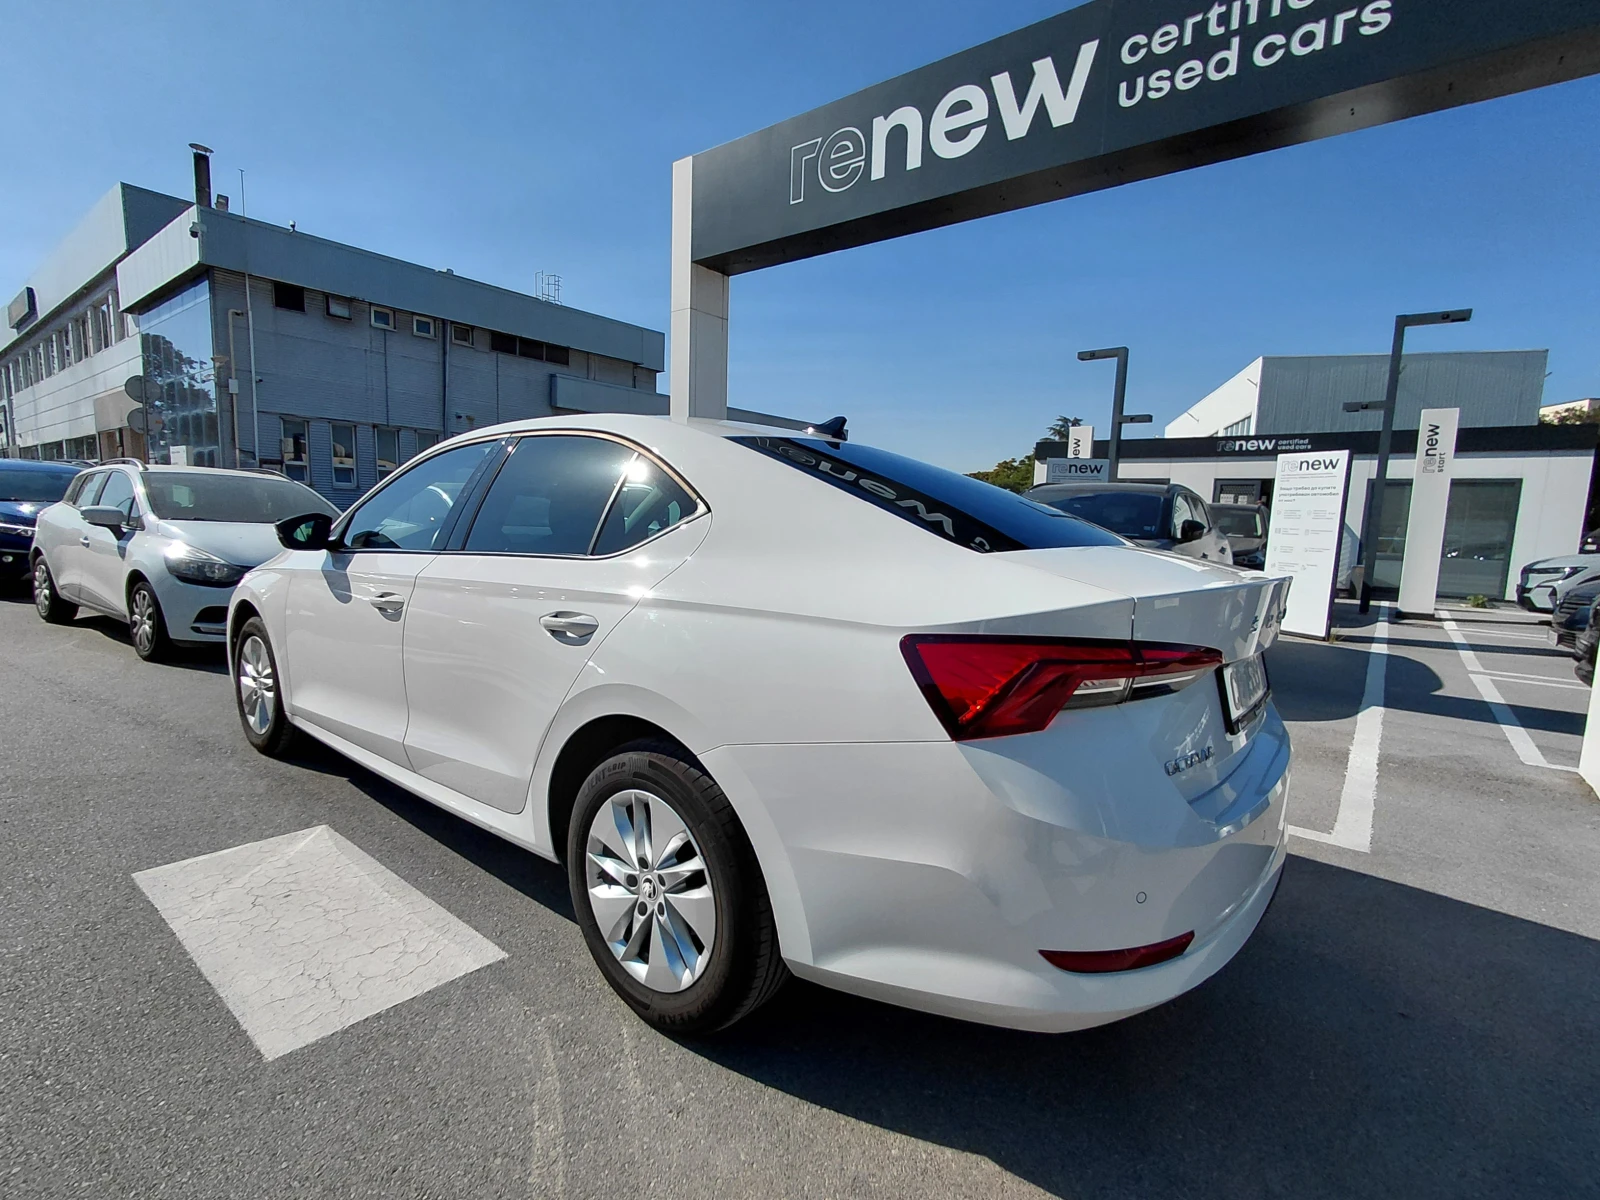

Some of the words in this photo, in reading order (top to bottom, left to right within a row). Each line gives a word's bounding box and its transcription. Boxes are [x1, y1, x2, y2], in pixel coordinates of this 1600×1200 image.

[1118, 36, 1240, 108] used
[1252, 0, 1392, 67] cars
[789, 38, 1100, 205] renew
[1216, 439, 1276, 452] renew
[1421, 423, 1441, 474] renew
[1051, 463, 1103, 474] renew
[1281, 458, 1340, 472] renew
[1437, 452, 1446, 473] start
